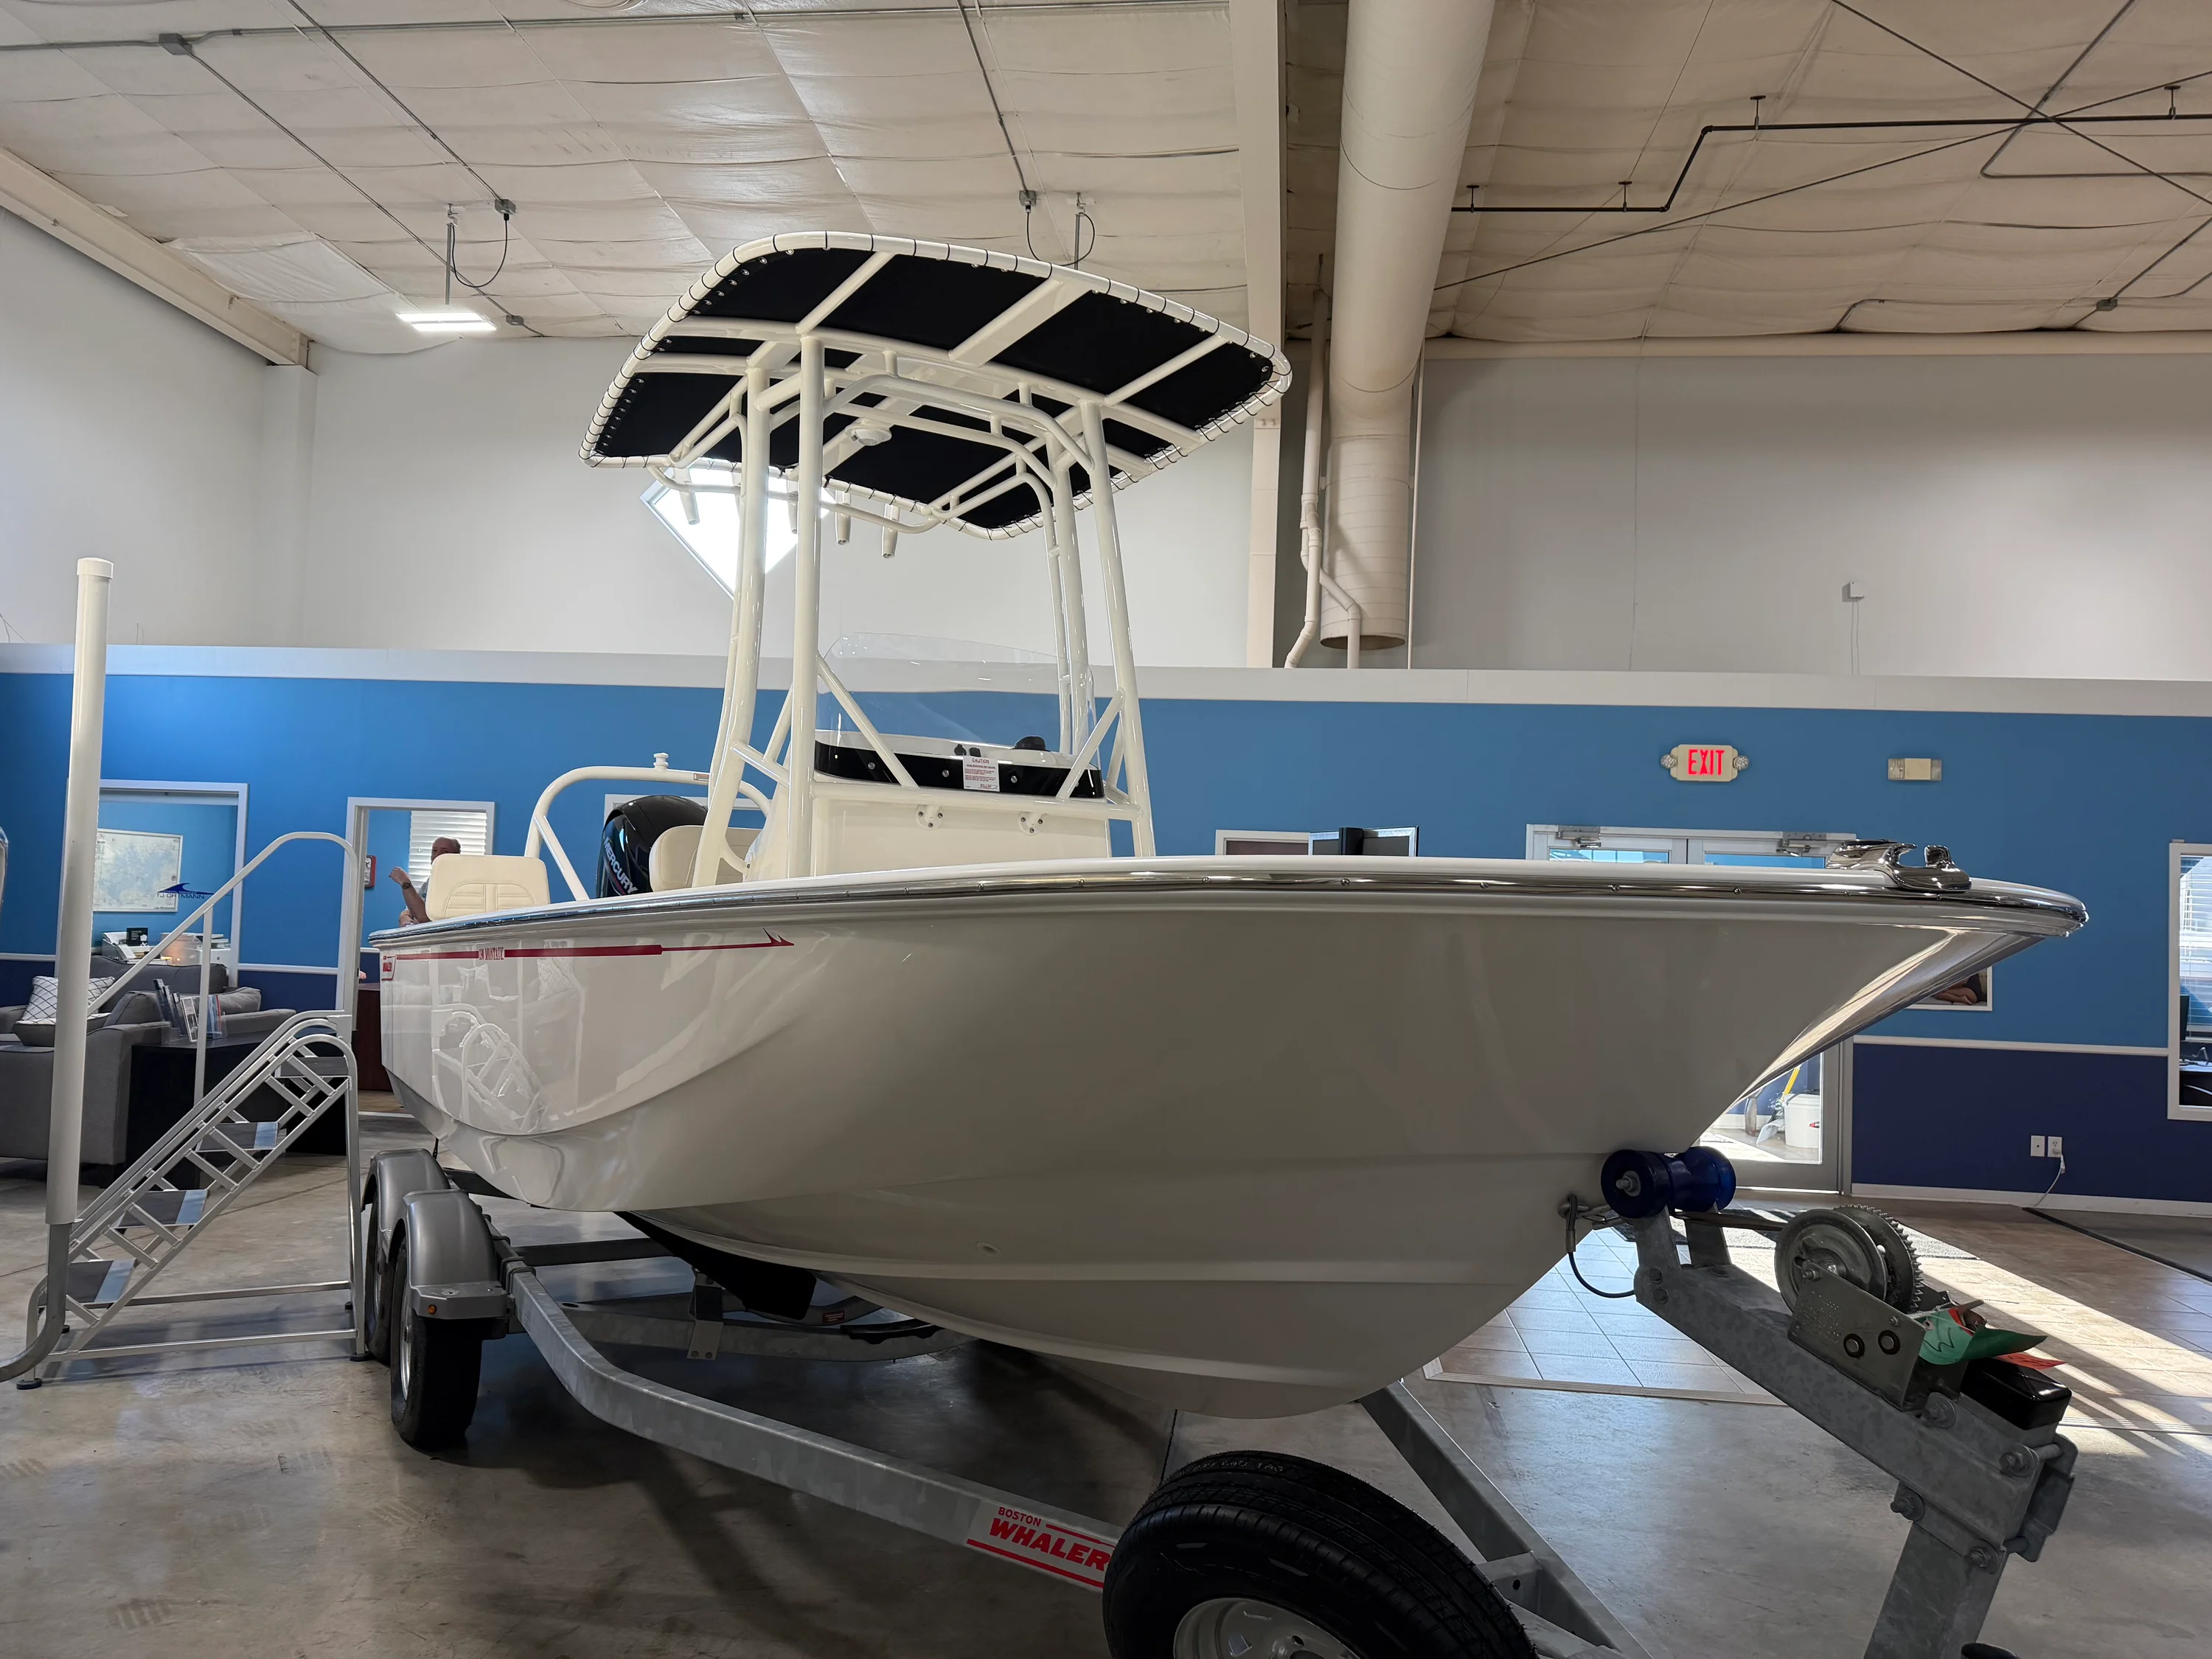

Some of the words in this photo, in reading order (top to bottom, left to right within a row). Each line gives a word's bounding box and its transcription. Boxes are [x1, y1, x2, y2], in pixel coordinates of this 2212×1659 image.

[1687, 748, 1725, 776] EXIT
[603, 836, 639, 894] MERCURY
[998, 1506, 1042, 1527] BOSTON
[990, 1517, 1110, 1571] WHALER
